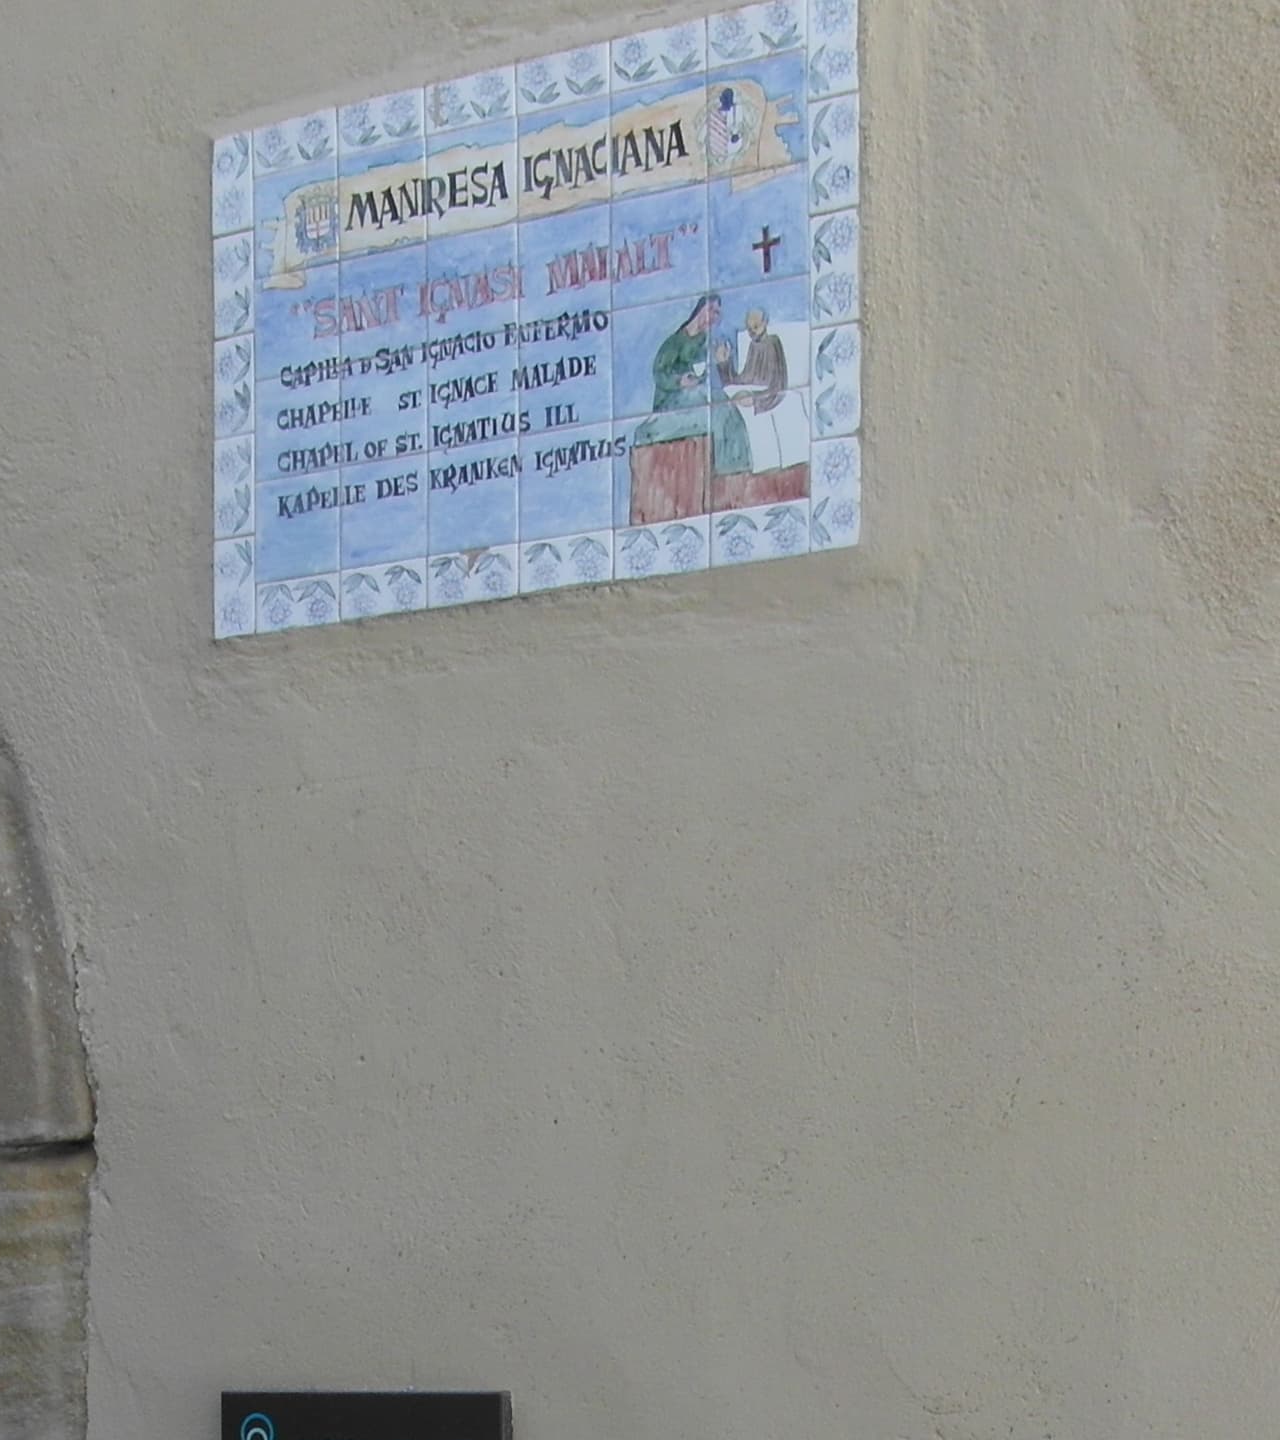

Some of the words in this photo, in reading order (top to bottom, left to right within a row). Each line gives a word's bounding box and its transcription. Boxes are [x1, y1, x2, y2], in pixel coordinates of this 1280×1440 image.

[345, 161, 508, 231] MANRESA
[524, 120, 689, 199] IGNACIANA
[417, 258, 524, 323] IGNASI
[277, 397, 372, 430] CHAPELLE
[430, 371, 498, 409] IGNACE
[510, 355, 597, 392] MALADE
[280, 356, 353, 390] CAPILLA
[375, 344, 415, 375] SAN
[421, 330, 495, 369] IGNACIO
[277, 441, 358, 473] CHAPEL
[364, 438, 388, 459] OF
[395, 432, 423, 456] ST.
[433, 410, 531, 454] IGNATIUS
[545, 402, 580, 428] ILL
[278, 484, 366, 519] KAPELLE
[376, 471, 418, 499] DES
[430, 453, 523, 494] KRANKEN
[535, 434, 627, 478] IGNATIUS
